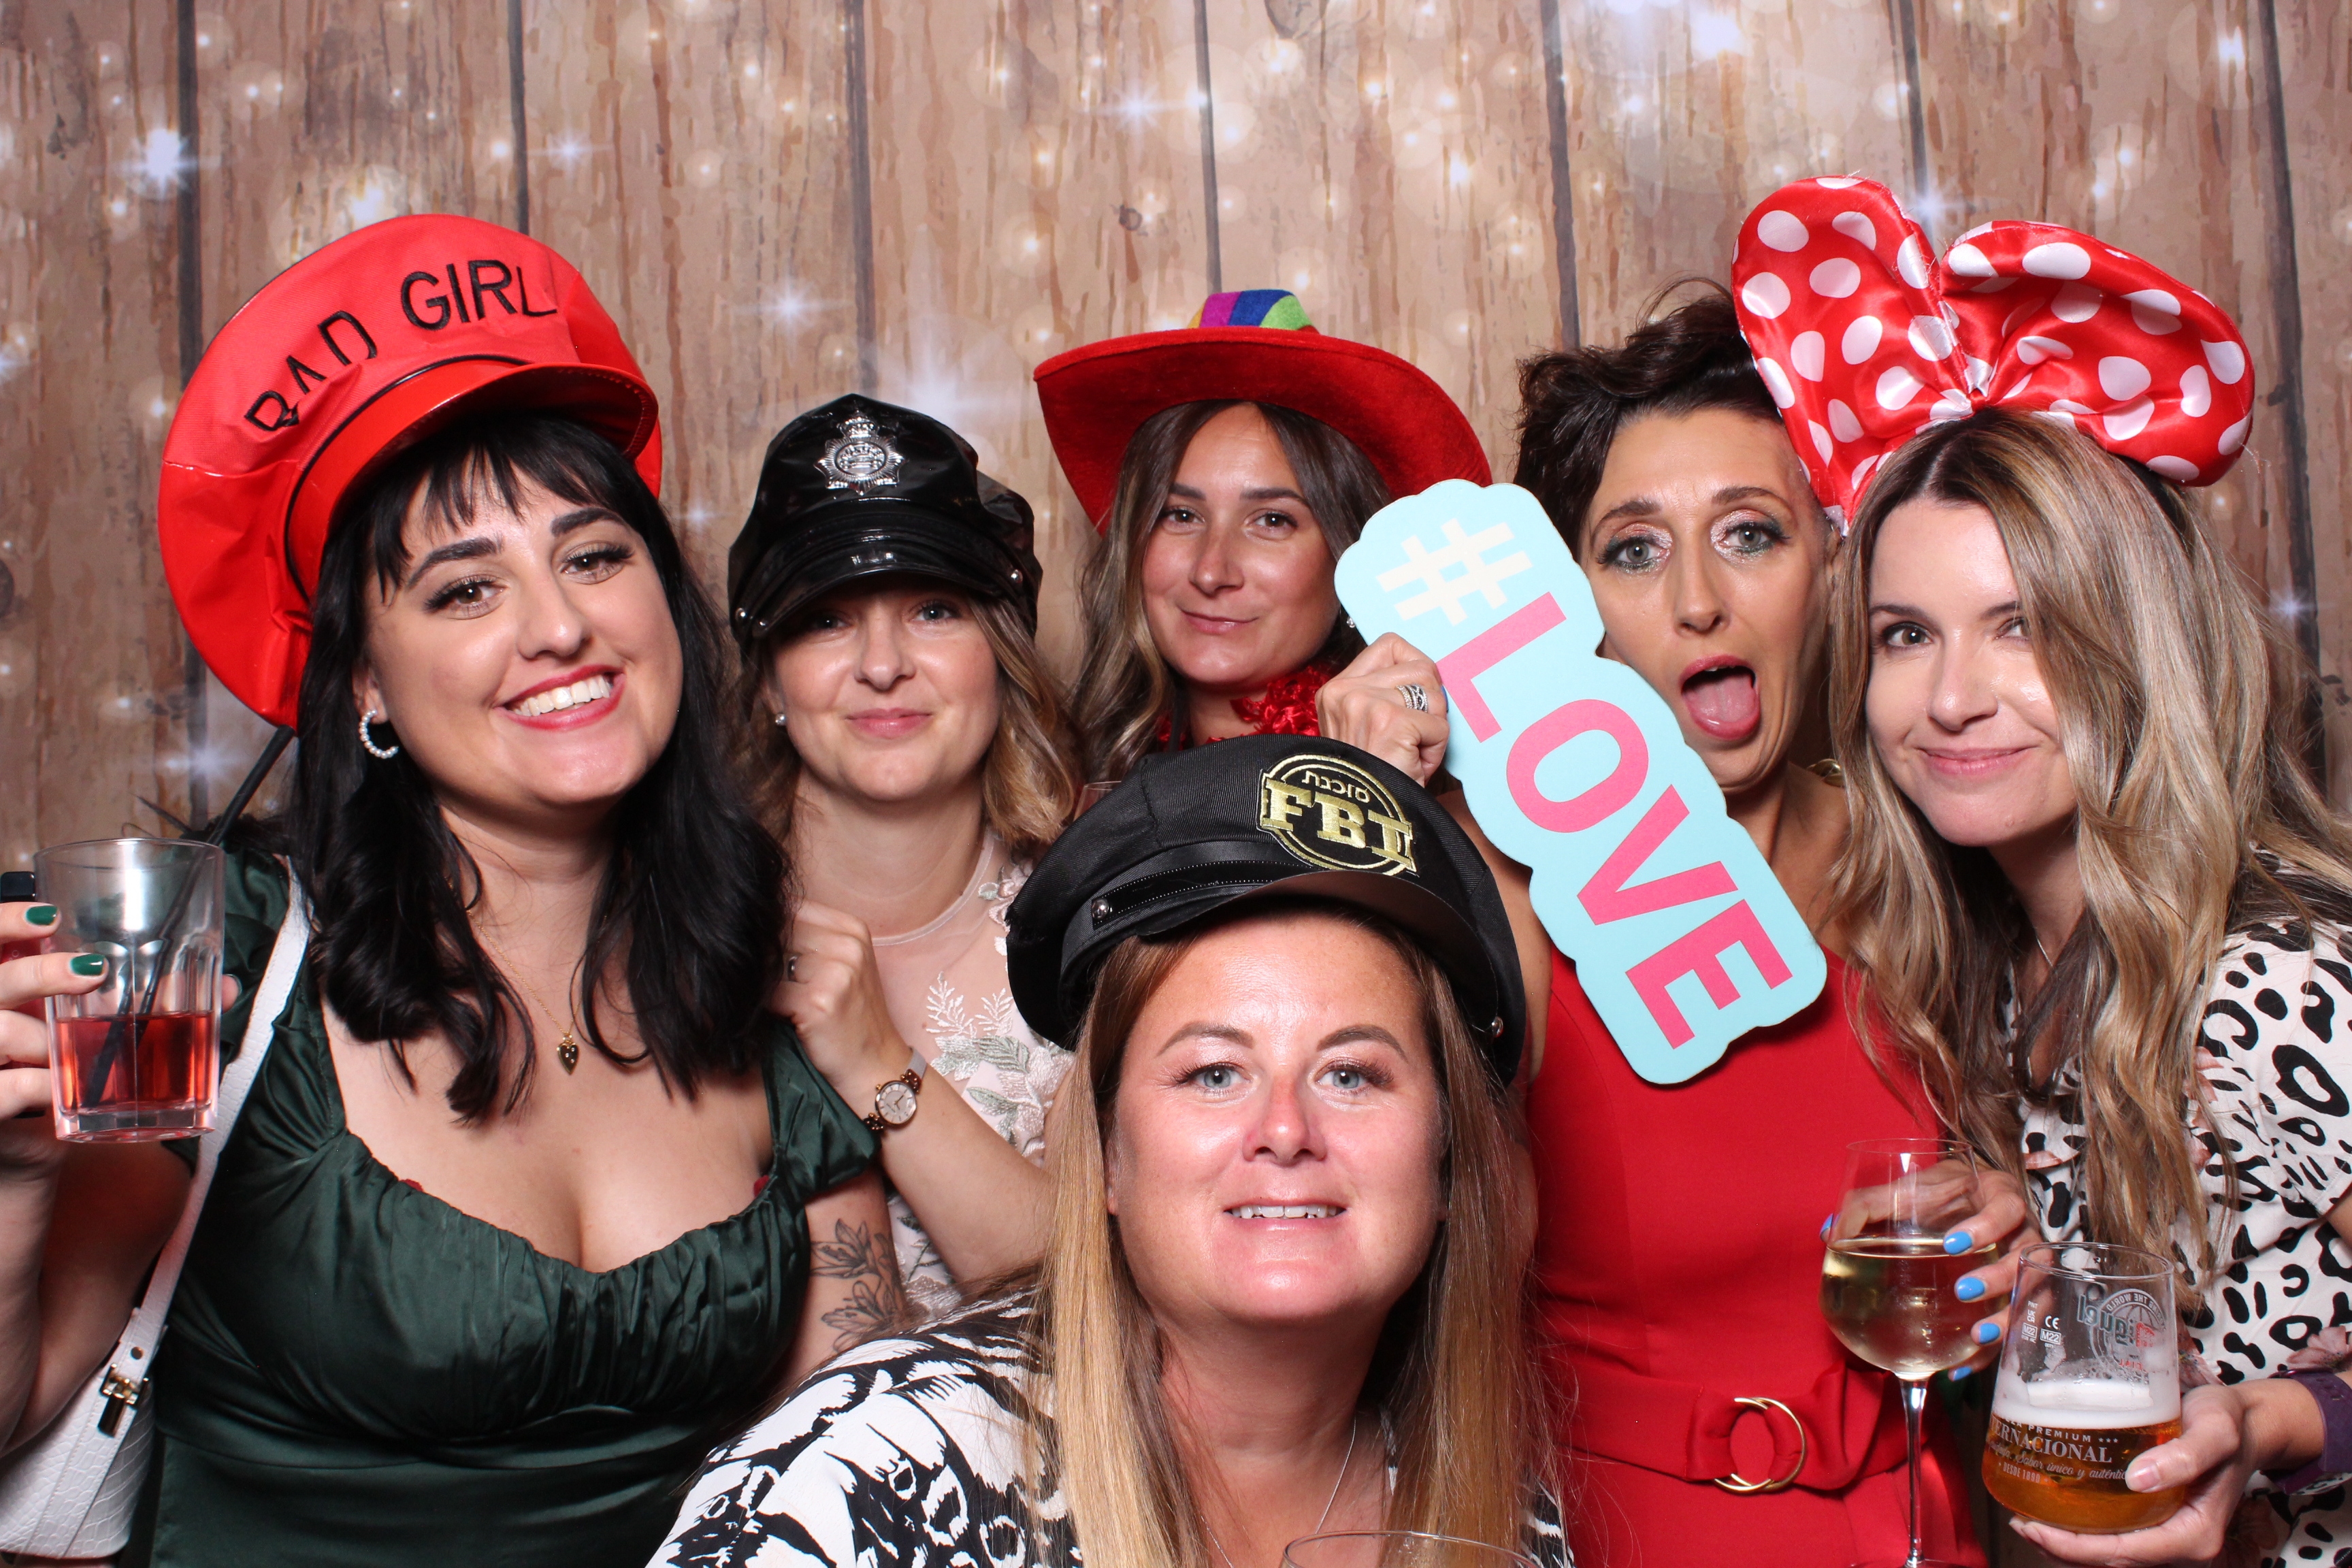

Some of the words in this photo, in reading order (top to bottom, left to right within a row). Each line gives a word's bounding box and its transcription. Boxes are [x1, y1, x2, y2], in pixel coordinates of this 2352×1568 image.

[400, 259, 557, 331] GIRL
[1376, 518, 1793, 1050] #LOVE
[1261, 778, 1414, 870] FBI
[2023, 1324, 2036, 1336] M22
[2042, 1330, 2059, 1343] M22
[1991, 1415, 2112, 1463] TERNACIONAL
[2028, 1424, 2091, 1442] PREMIUM
[2003, 1461, 2021, 1477] DESDE
[2023, 1469, 2040, 1484] 1890
[2076, 1469, 2086, 1480] y
[2089, 1468, 2126, 1480] auténtic
